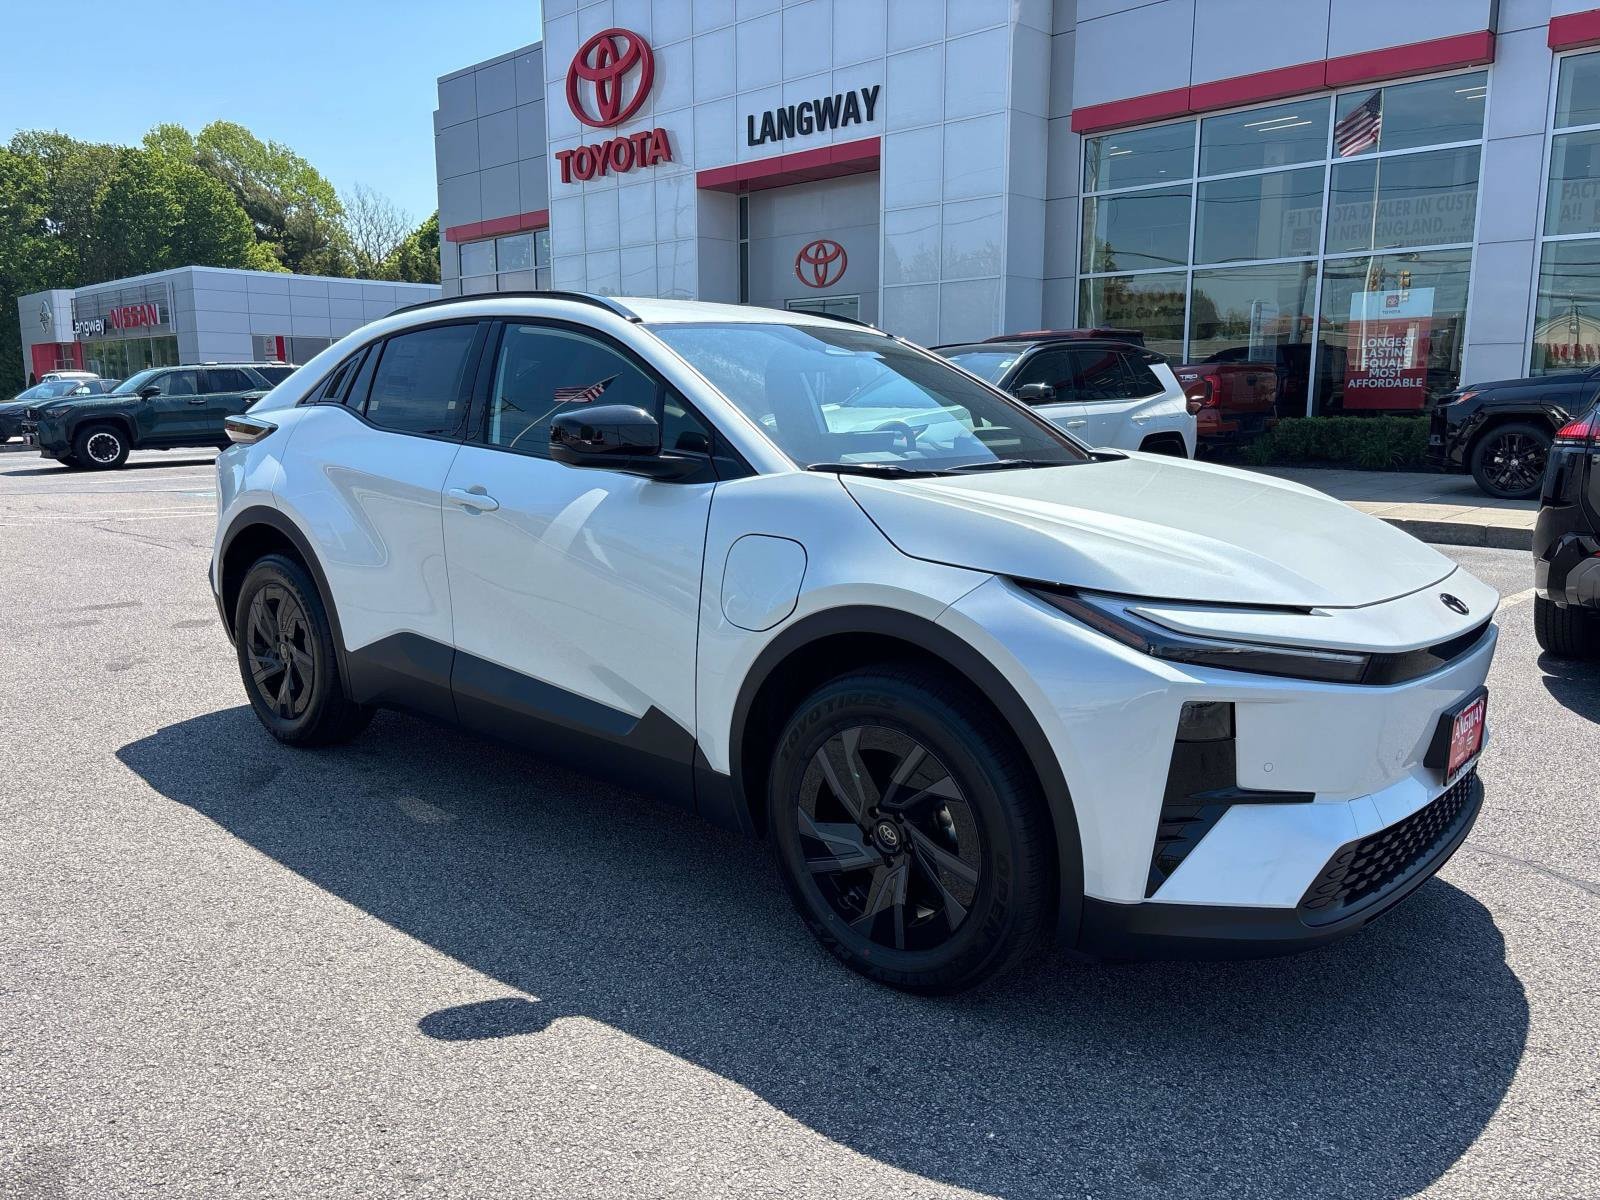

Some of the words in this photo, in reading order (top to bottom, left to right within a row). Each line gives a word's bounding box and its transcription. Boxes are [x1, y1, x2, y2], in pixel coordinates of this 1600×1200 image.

[748, 85, 880, 147] LANGWAY
[555, 128, 673, 184] TOYOTA
[1306, 205, 1358, 225] TOOTA
[1361, 200, 1410, 220] DALER
[1416, 197, 1432, 215] IN
[1436, 192, 1476, 212] CUST
[72, 319, 105, 337] Langway
[110, 304, 160, 329] NISSAN
[1362, 336, 1415, 347] LONGEST
[1362, 347, 1413, 358] LASTING
[1362, 358, 1411, 369] EQUALS
[1369, 368, 1401, 378] MOST
[1348, 378, 1423, 389] AFFORDABLE
[781, 709, 821, 761] TOYO
[825, 694, 901, 715] TIRES
